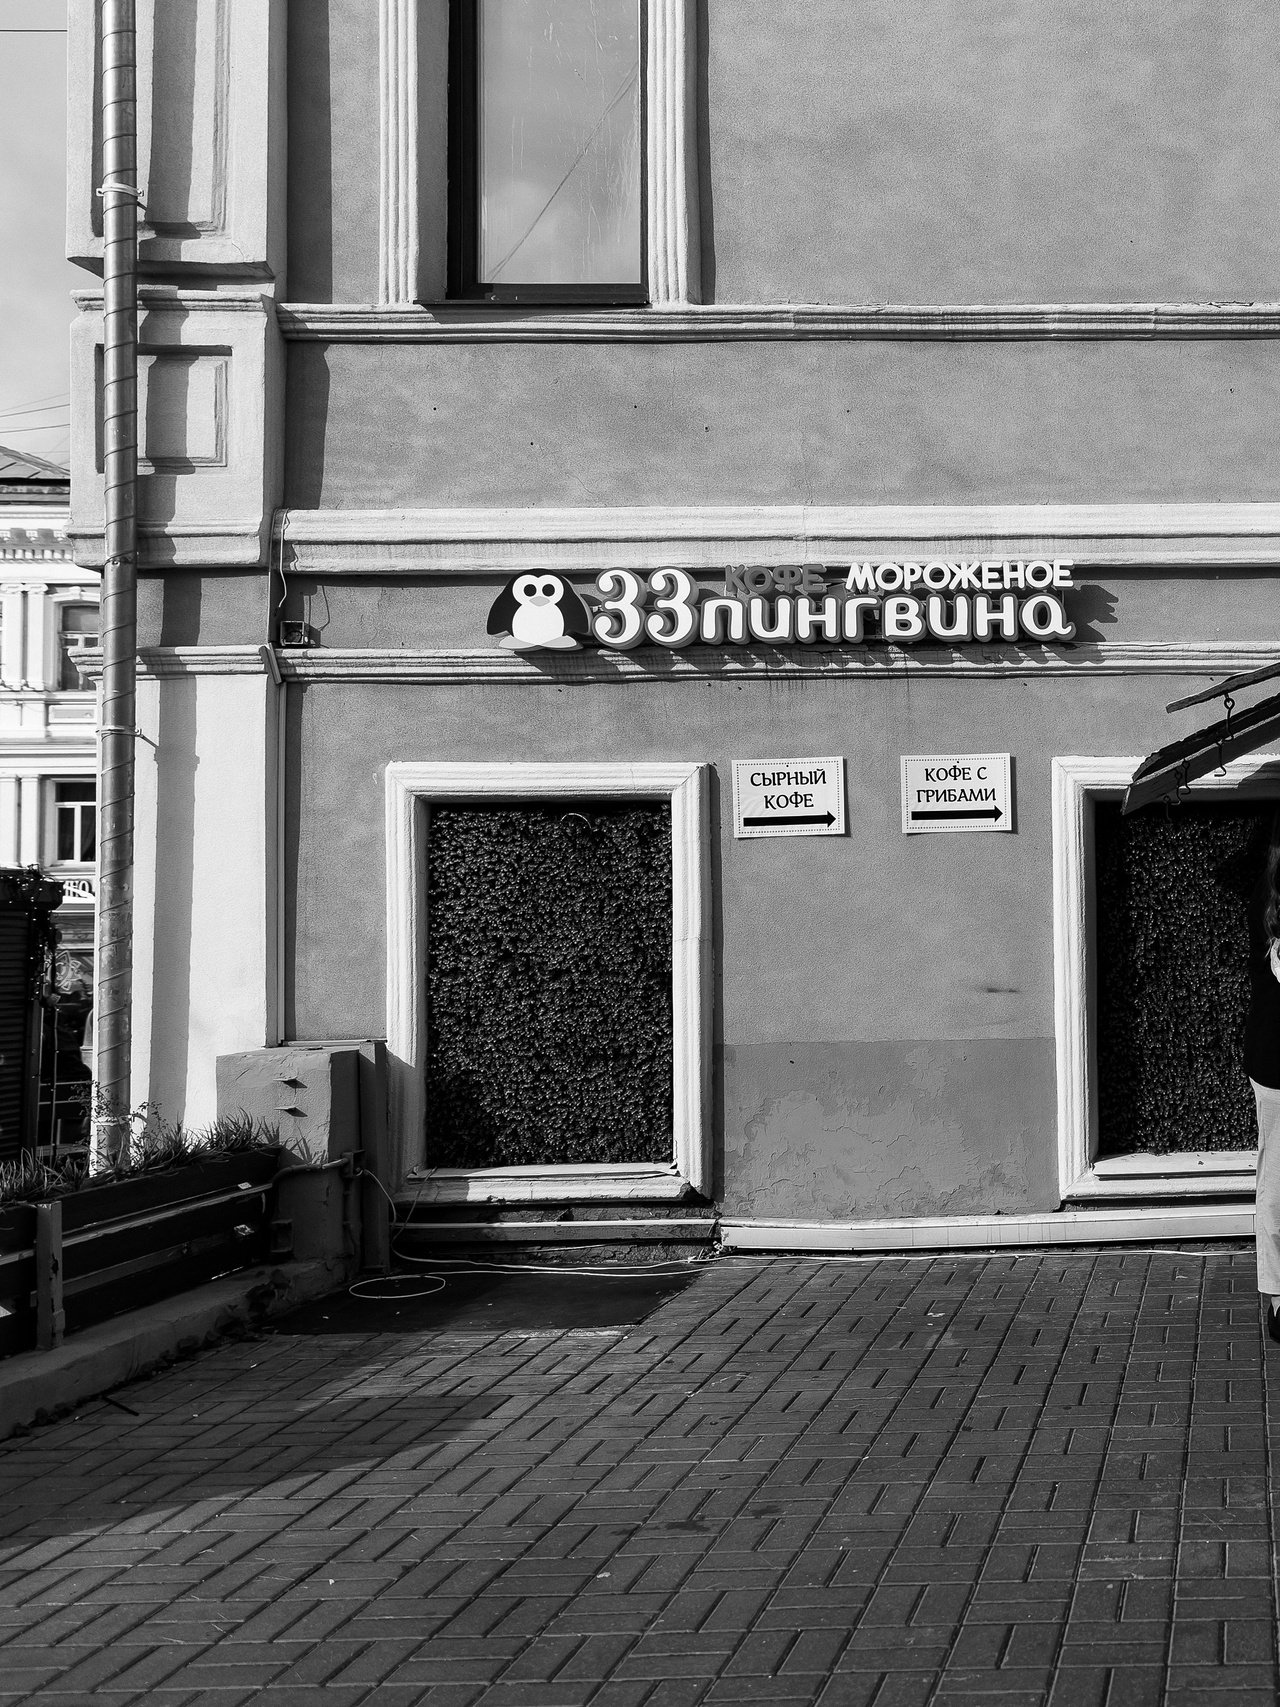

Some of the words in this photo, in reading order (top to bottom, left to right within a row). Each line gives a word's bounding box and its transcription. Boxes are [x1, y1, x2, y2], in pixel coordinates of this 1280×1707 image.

[725, 564, 828, 594] КОФЕ
[845, 559, 1075, 591] МОРОЖЕНОЕ
[750, 768, 827, 787] СЫРНЫЙ
[925, 765, 971, 782] КОФЕ
[977, 766, 987, 780] С
[764, 792, 814, 809] КОФЕ
[917, 788, 997, 803] ГРИБАМИ
